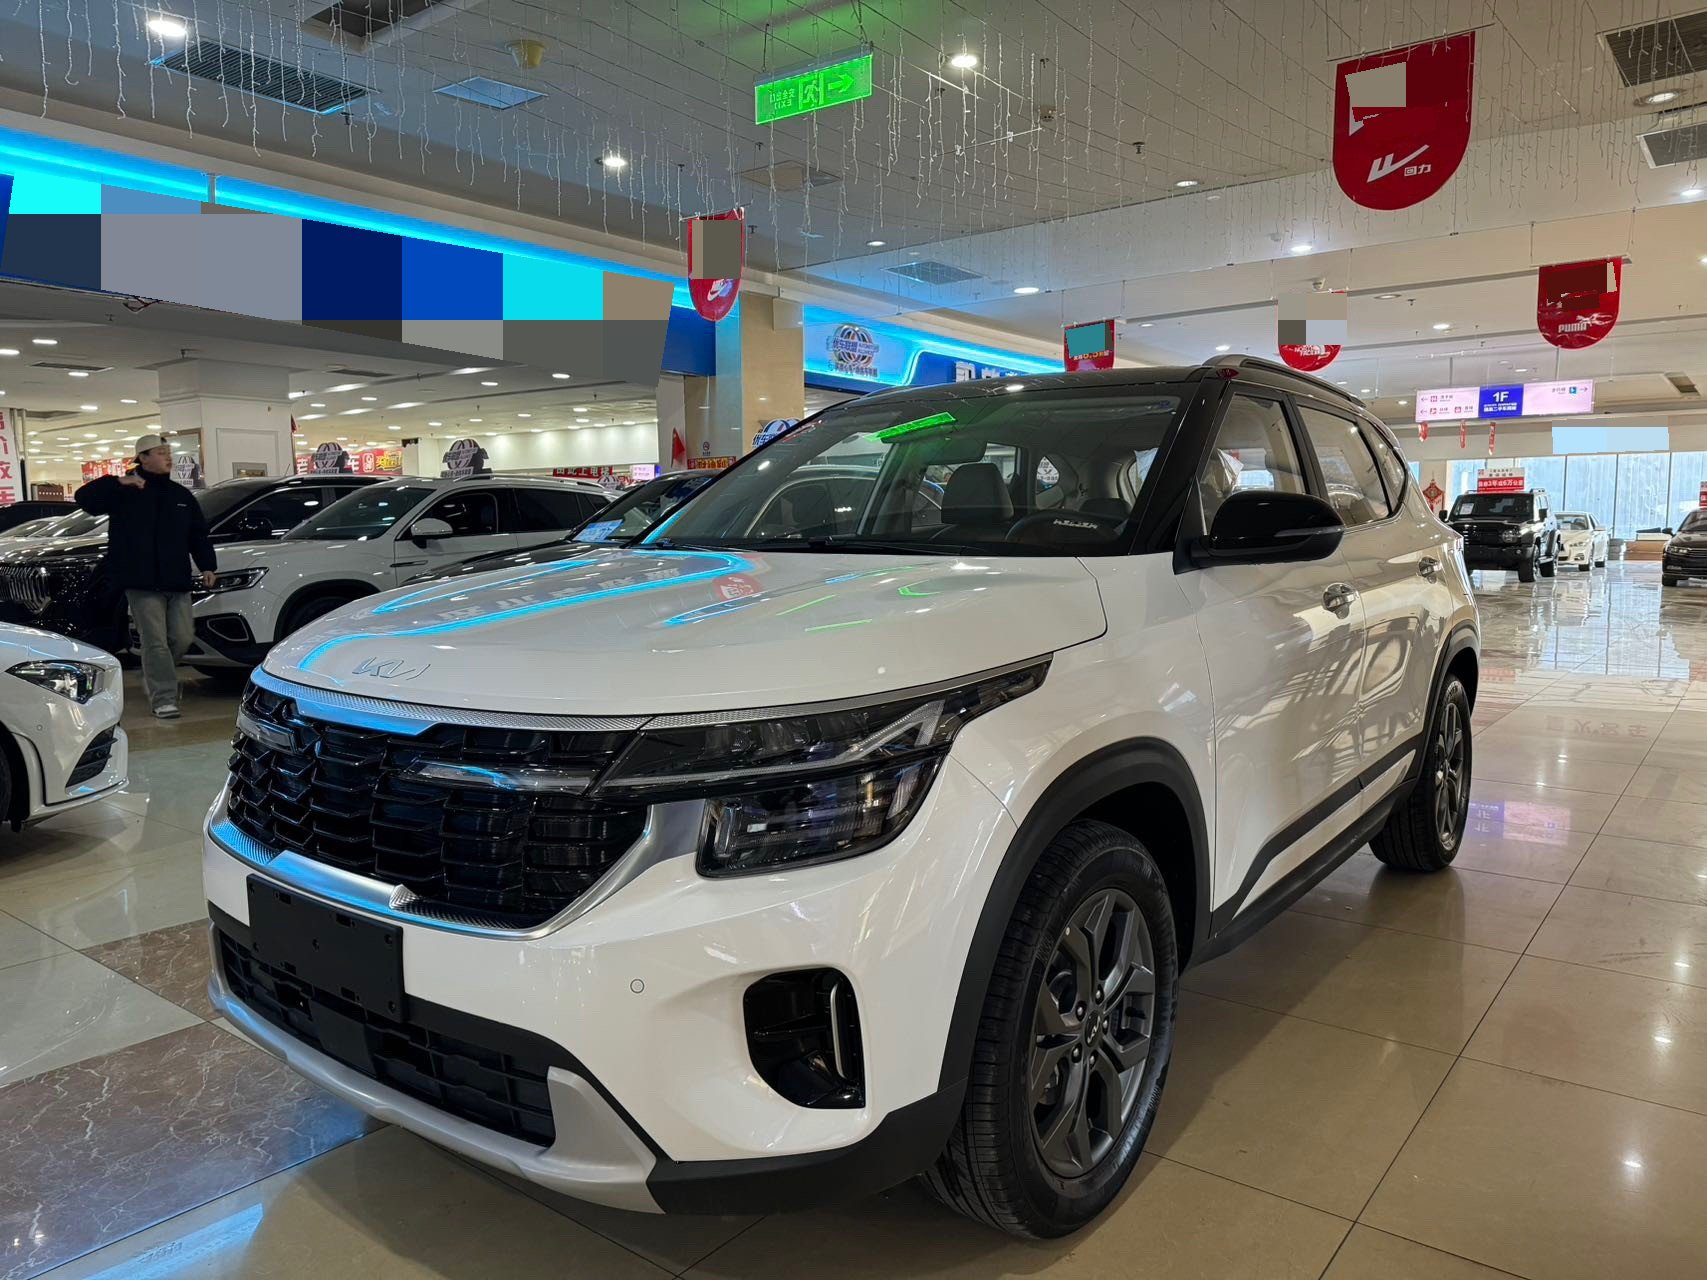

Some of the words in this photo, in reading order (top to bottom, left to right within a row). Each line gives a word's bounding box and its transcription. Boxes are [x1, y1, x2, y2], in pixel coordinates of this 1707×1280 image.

[1404, 163, 1431, 177] 回力
[1558, 322, 1587, 333] PUMA
[1492, 391, 1509, 402] 1F
[352, 656, 431, 681] KIA
